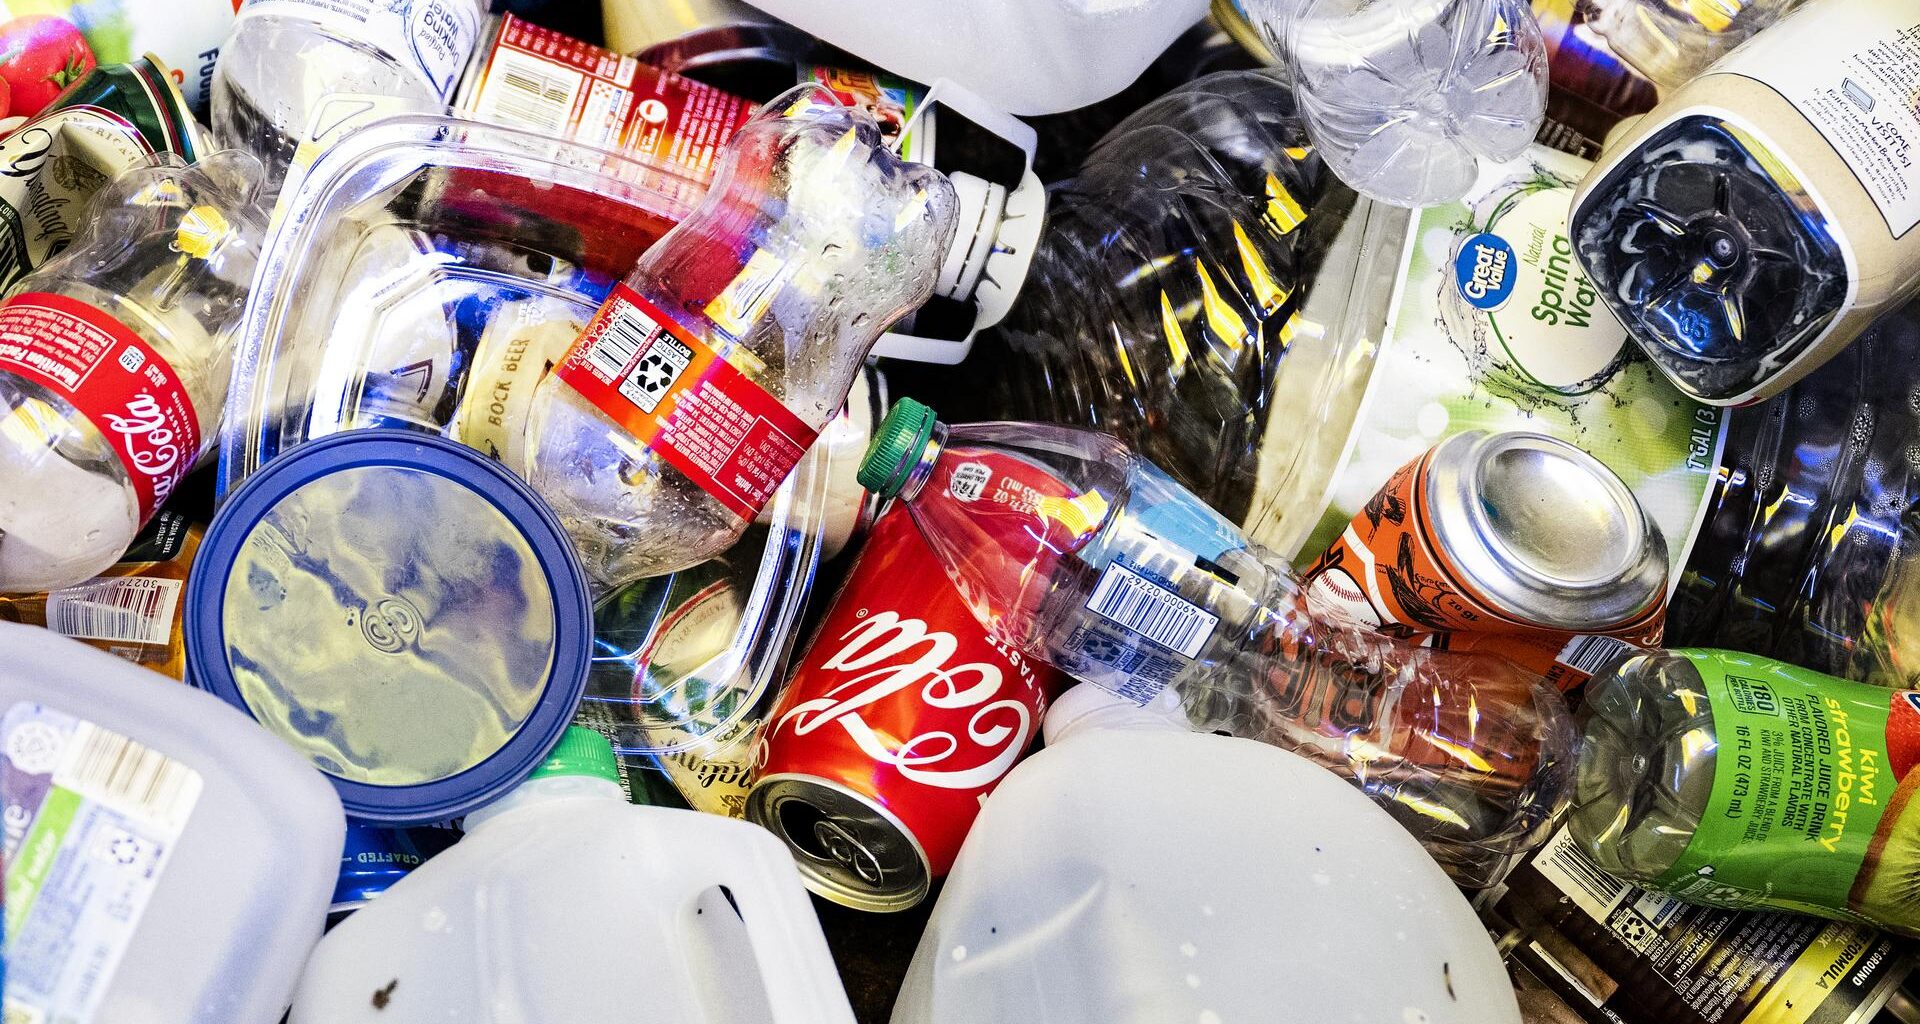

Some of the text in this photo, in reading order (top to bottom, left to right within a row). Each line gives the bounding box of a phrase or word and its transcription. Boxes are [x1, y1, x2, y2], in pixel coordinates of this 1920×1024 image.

[423, 12, 459, 67] Drinking
[1869, 116, 1897, 146] VISIT
[1884, 120, 1912, 152] COME
[1522, 223, 1548, 268] Natural
[1464, 243, 1497, 299] Great
[1485, 248, 1509, 292] Value
[1564, 273, 1598, 328] Wat
[655, 340, 686, 365] PLASTIC
[662, 332, 691, 357] BOTTLE
[26, 350, 79, 387] Nutrition
[487, 377, 513, 428] BOCK
[162, 535, 174, 552] TASTE
[1126, 573, 1161, 597] 02762
[1162, 592, 1197, 616] 49000
[984, 633, 1042, 689] TASTE
[772, 608, 1032, 790] Cola
[1733, 688, 1746, 710] BOTTLE
[1738, 679, 1755, 710] CALORIES
[1750, 684, 1774, 710] 180
[1771, 731, 1783, 745] 3%
[1725, 725, 1750, 818] 16 FL OZ (473 mL)
[1774, 749, 1783, 773] JUICE
[1781, 697, 1800, 826] OTHER NATURAL FLAVORS
[1793, 698, 1810, 830] FROM CONCENTRATE WITH
[1805, 694, 1830, 842] FLAVORED JUICE DRINK
[1820, 698, 1857, 852] strawberry
[1858, 749, 1877, 805] kiwi
[1741, 729, 1770, 845] KIWI AND STRAWBERRY JUICES
[1769, 776, 1781, 799] FROM
[1759, 808, 1774, 831] BLEND
[357, 852, 418, 864] CRAFTED
[1707, 915, 1728, 939] every
[1816, 923, 1839, 948] DUCK
[1672, 937, 1711, 979] ingredient
[1674, 932, 1703, 964] purpose
[1815, 938, 1862, 992] FORMULA
[1717, 973, 1740, 997] VITAMINS
[1850, 951, 1883, 987] GROUND
